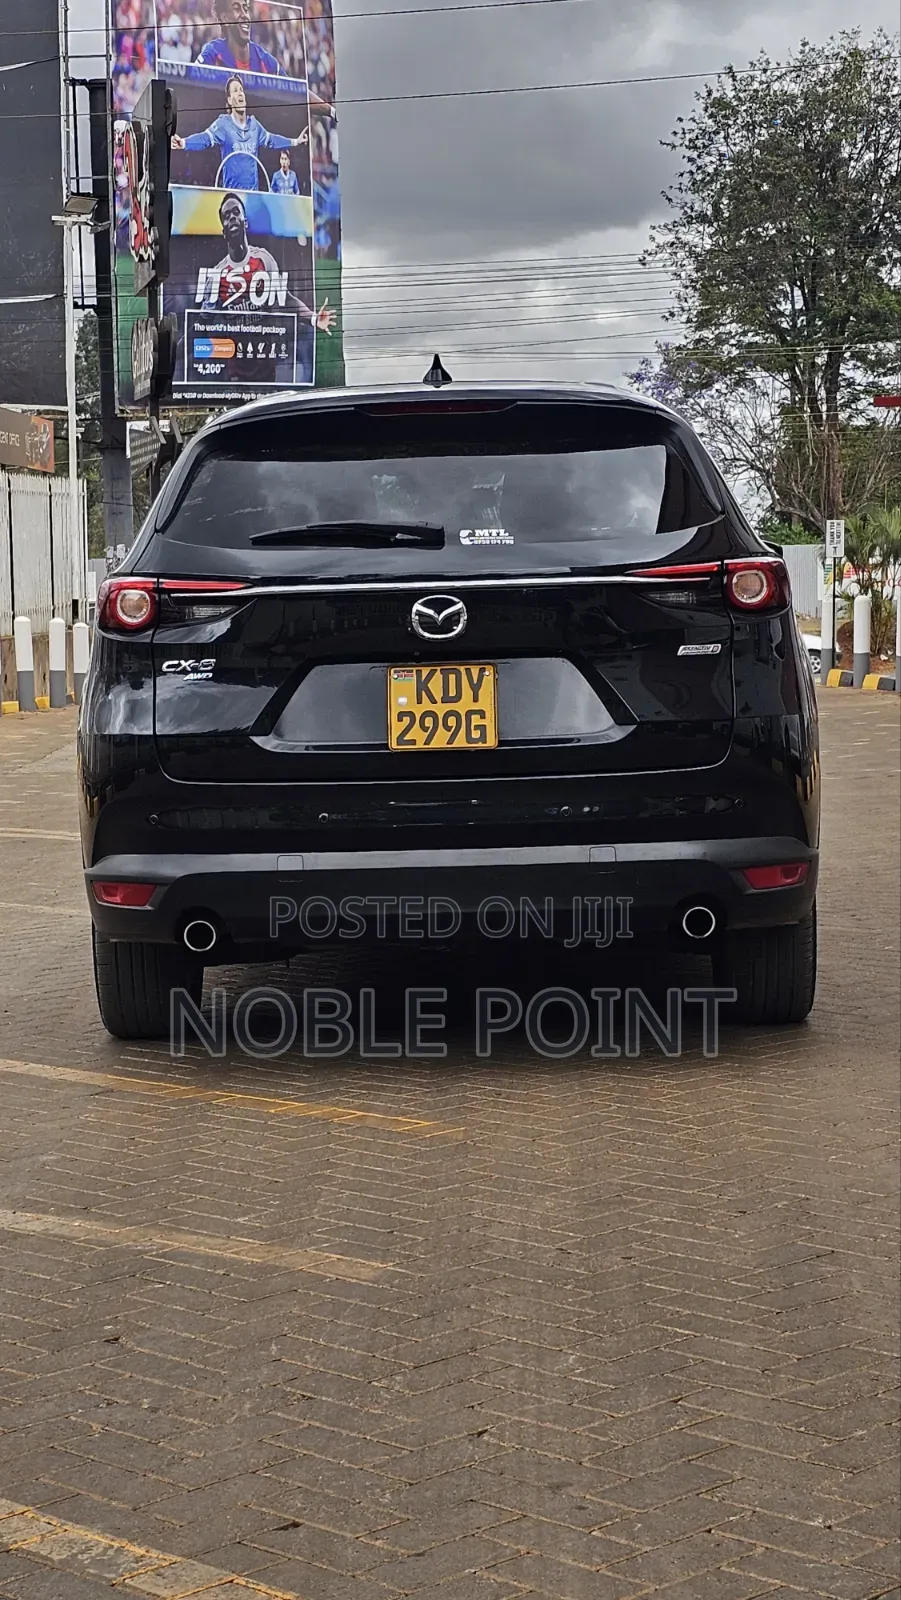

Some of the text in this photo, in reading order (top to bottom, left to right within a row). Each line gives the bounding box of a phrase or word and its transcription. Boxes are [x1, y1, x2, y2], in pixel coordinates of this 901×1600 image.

[249, 271, 288, 306] ON
[194, 323, 286, 336] The world's best football package
[161, 658, 217, 672] CX-8
[182, 672, 214, 681] AWD
[415, 667, 486, 705] KDY
[396, 709, 488, 746] 299G
